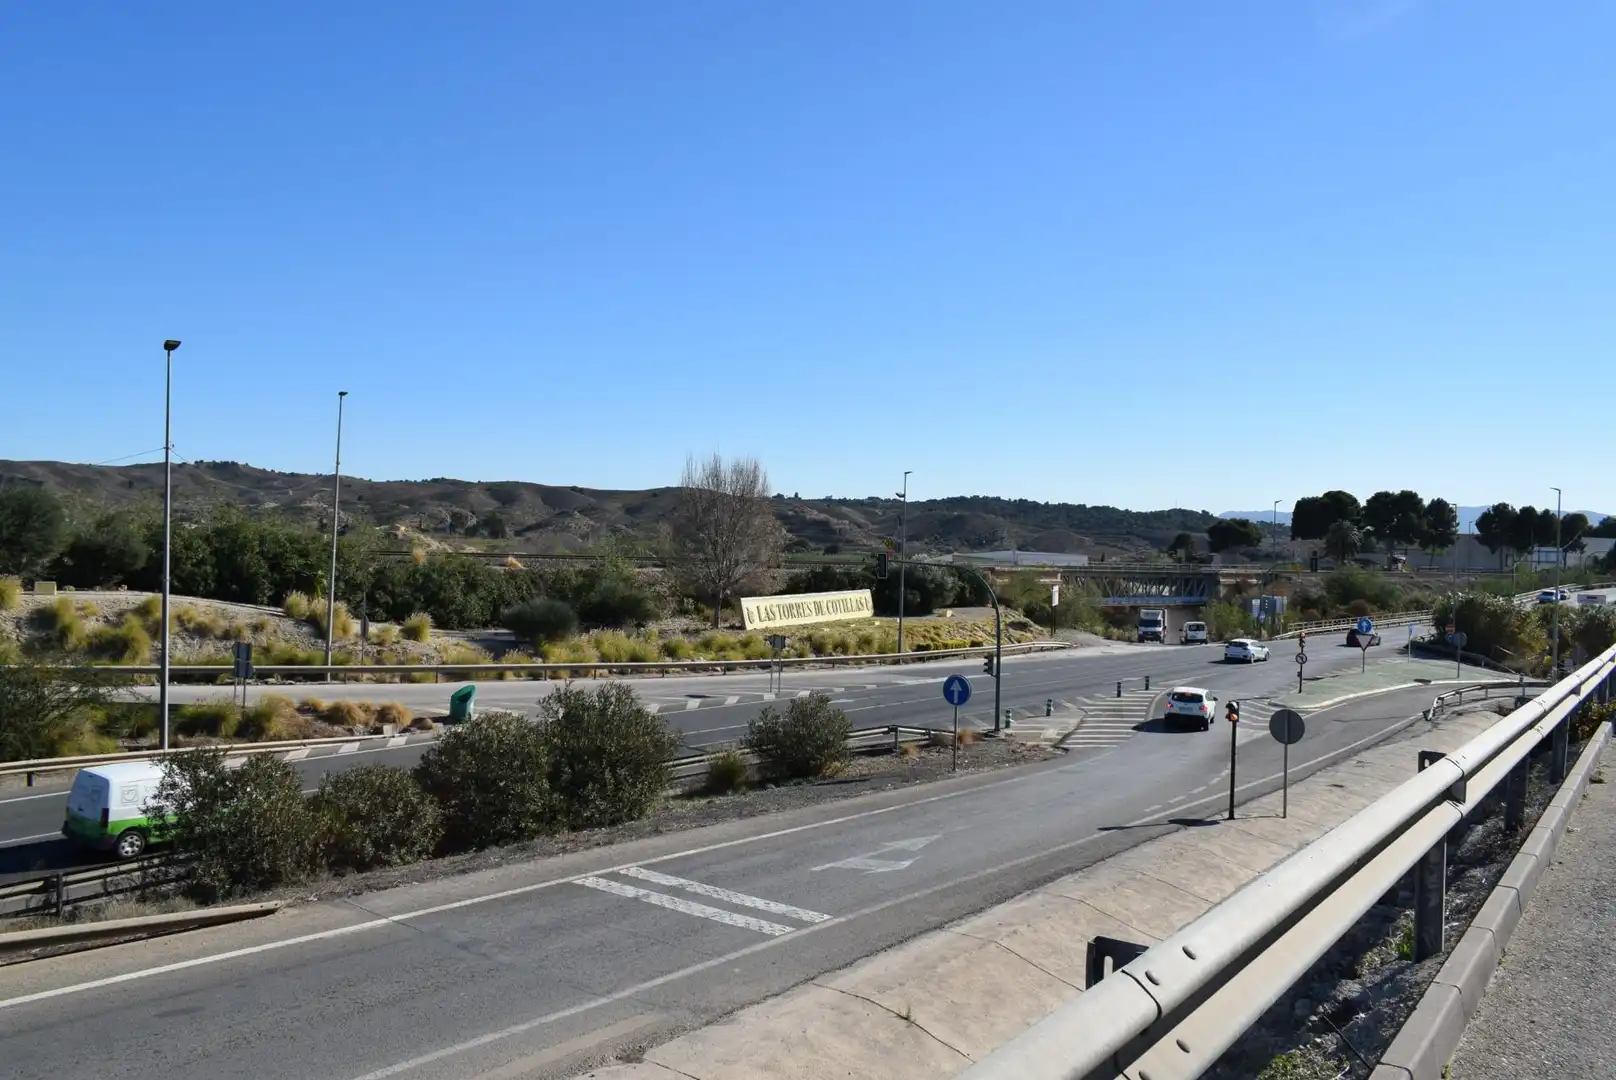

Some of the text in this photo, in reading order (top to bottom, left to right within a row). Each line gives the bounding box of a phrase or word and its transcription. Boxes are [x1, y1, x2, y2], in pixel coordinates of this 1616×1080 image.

[756, 597, 865, 622] LAS TORRES DE COTILLAS
